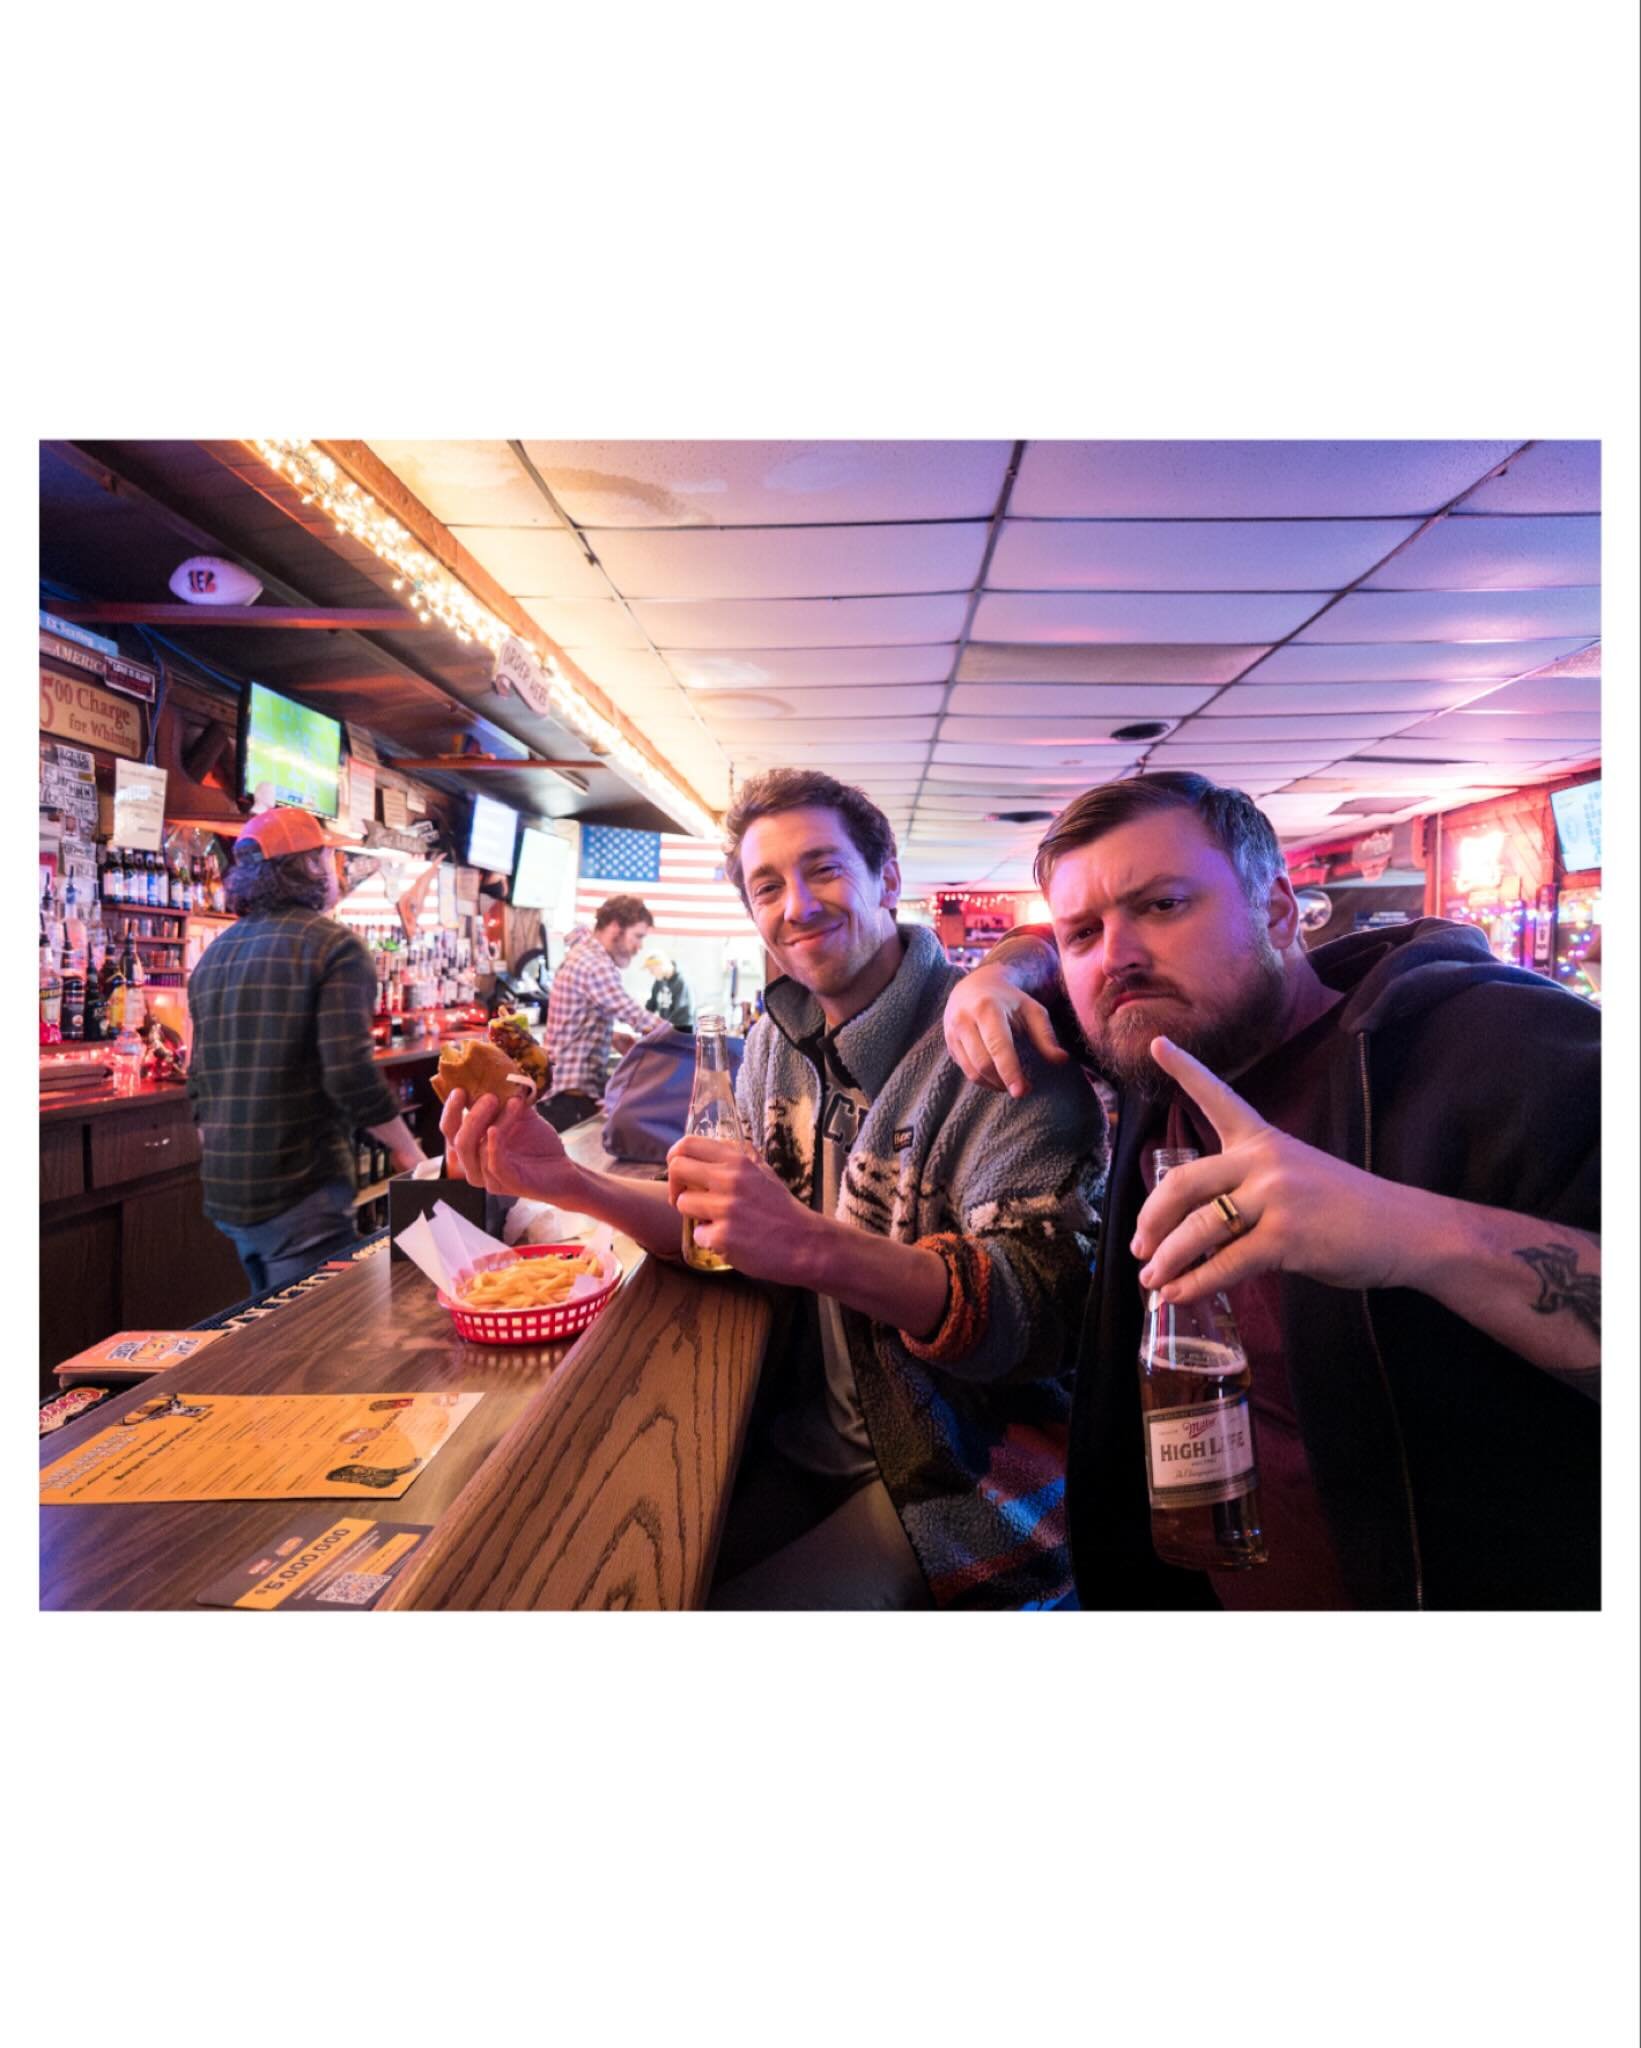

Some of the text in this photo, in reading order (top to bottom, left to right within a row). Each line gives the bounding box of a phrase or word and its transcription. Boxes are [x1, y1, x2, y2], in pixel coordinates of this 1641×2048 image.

[77, 688, 130, 730] Charge
[69, 713, 137, 755] for Whining
[1183, 1417, 1217, 1439] Miller
[1160, 1441, 1206, 1462] HIGH
